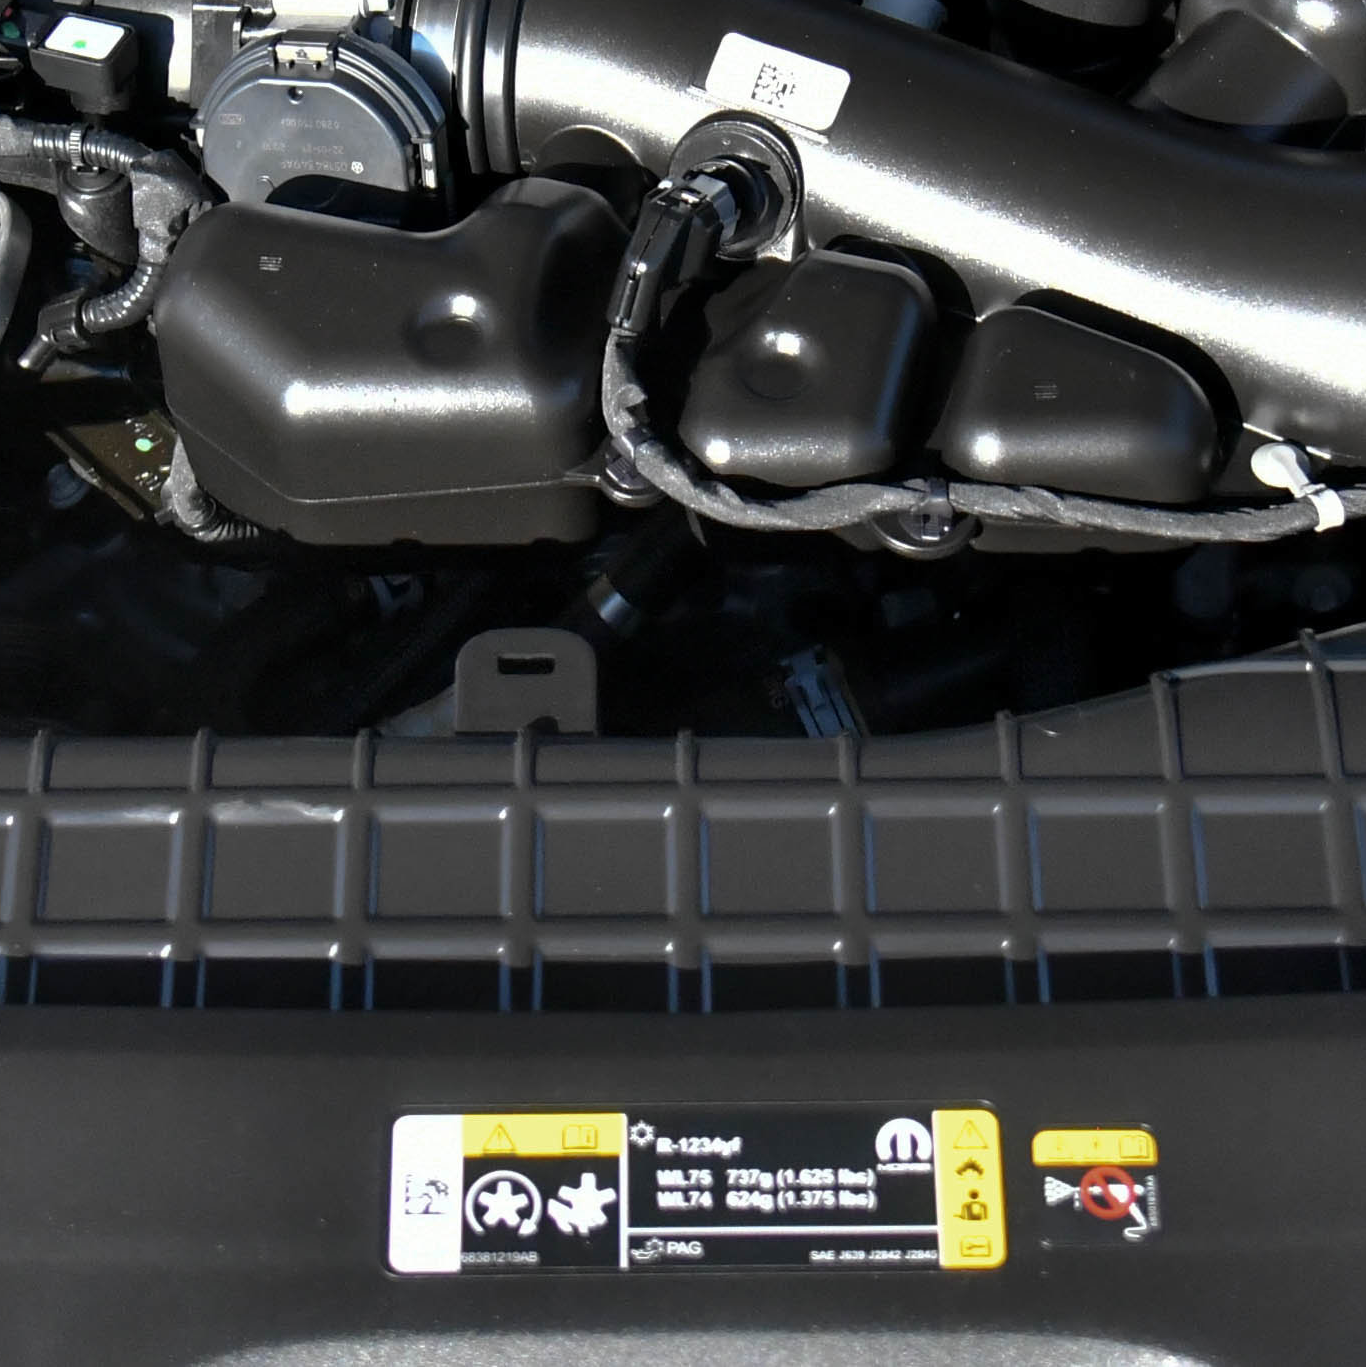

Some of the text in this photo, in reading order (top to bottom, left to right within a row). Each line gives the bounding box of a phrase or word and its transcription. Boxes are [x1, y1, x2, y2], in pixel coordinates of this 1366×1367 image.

[656, 1136, 742, 1157] R-1234yf
[656, 1168, 877, 1191] WL75 737g (1.625 lbs)
[656, 1190, 878, 1213] WL74 624g (1.375 lbs)
[666, 1241, 704, 1257] PAG
[809, 1250, 836, 1261] SAE
[838, 1250, 866, 1261] J639
